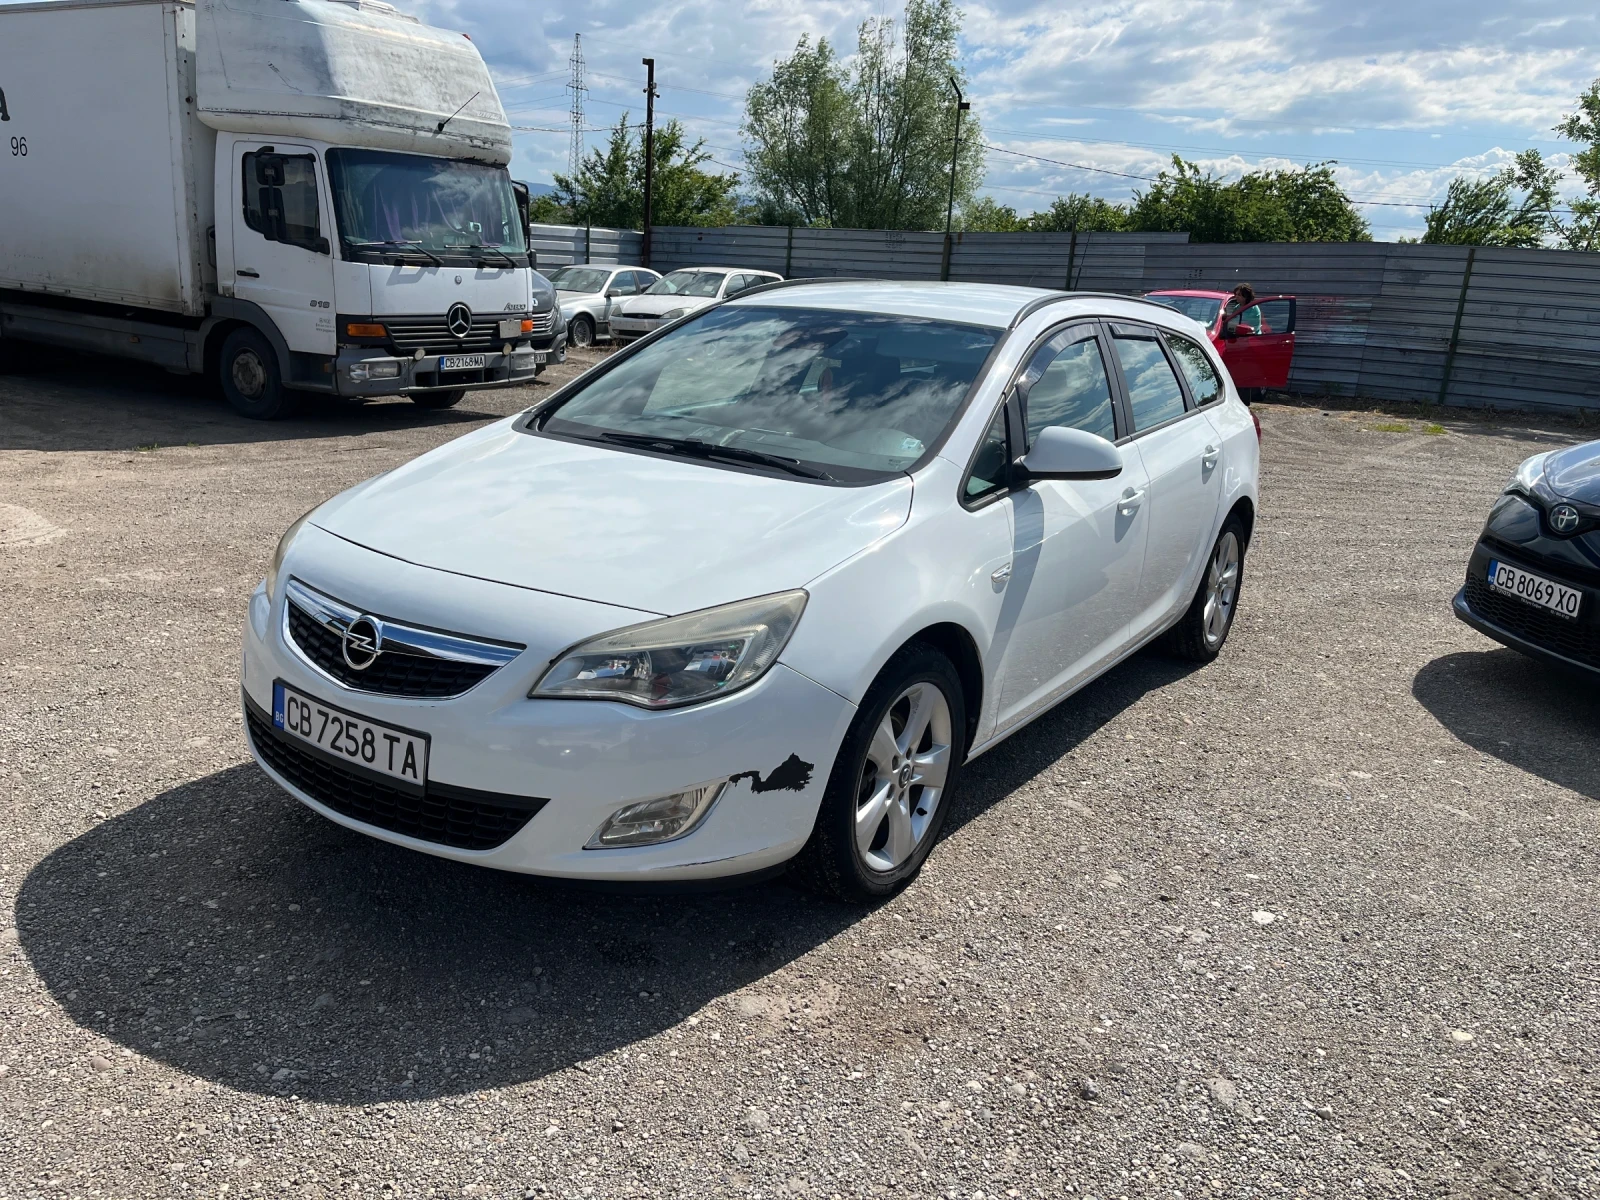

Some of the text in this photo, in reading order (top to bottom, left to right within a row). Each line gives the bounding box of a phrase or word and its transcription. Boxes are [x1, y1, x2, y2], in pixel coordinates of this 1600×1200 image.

[10, 136, 28, 156] 96
[1496, 566, 1516, 589] CB
[1516, 574, 1554, 605] 8069
[275, 710, 284, 723] BG
[287, 696, 418, 780] CB 7258 TA
